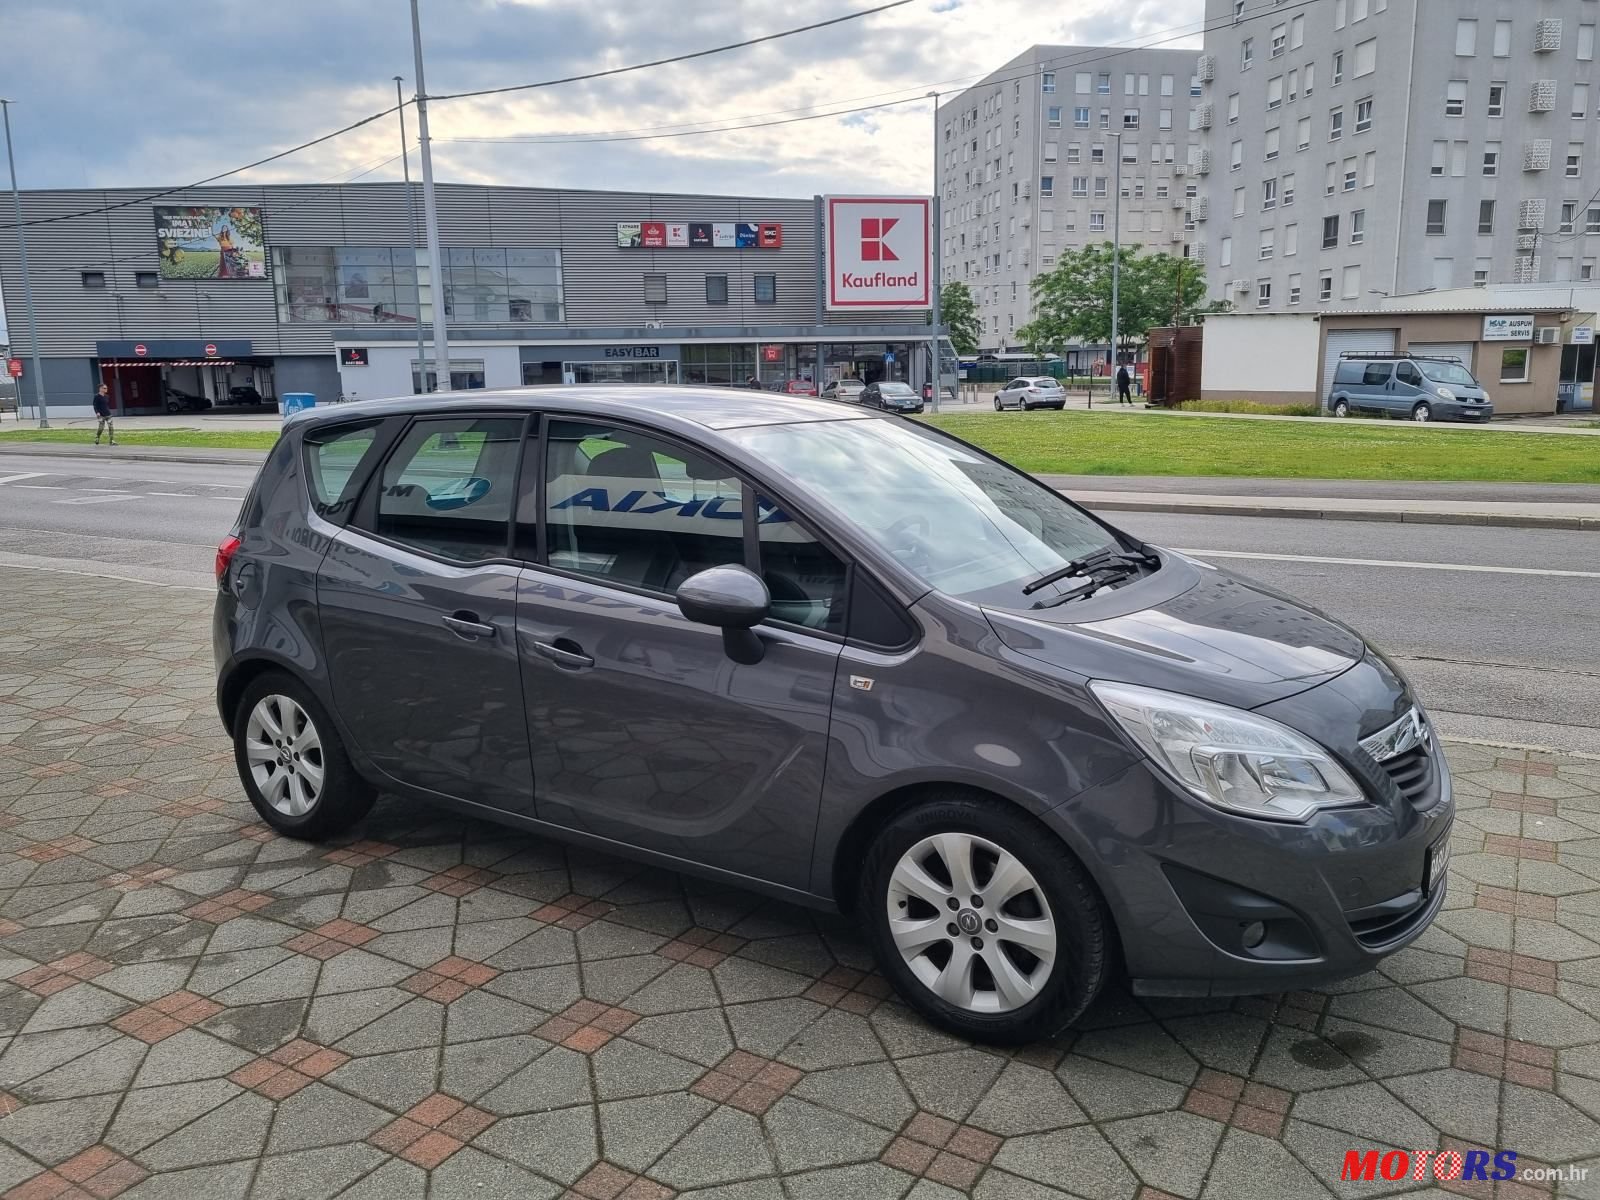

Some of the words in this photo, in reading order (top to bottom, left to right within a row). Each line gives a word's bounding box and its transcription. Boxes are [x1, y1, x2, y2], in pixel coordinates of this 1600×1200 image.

[842, 271, 918, 288] Kaufland
[1510, 329, 1530, 337] SERVIS
[605, 348, 633, 357] EASY
[635, 348, 657, 357] BAR
